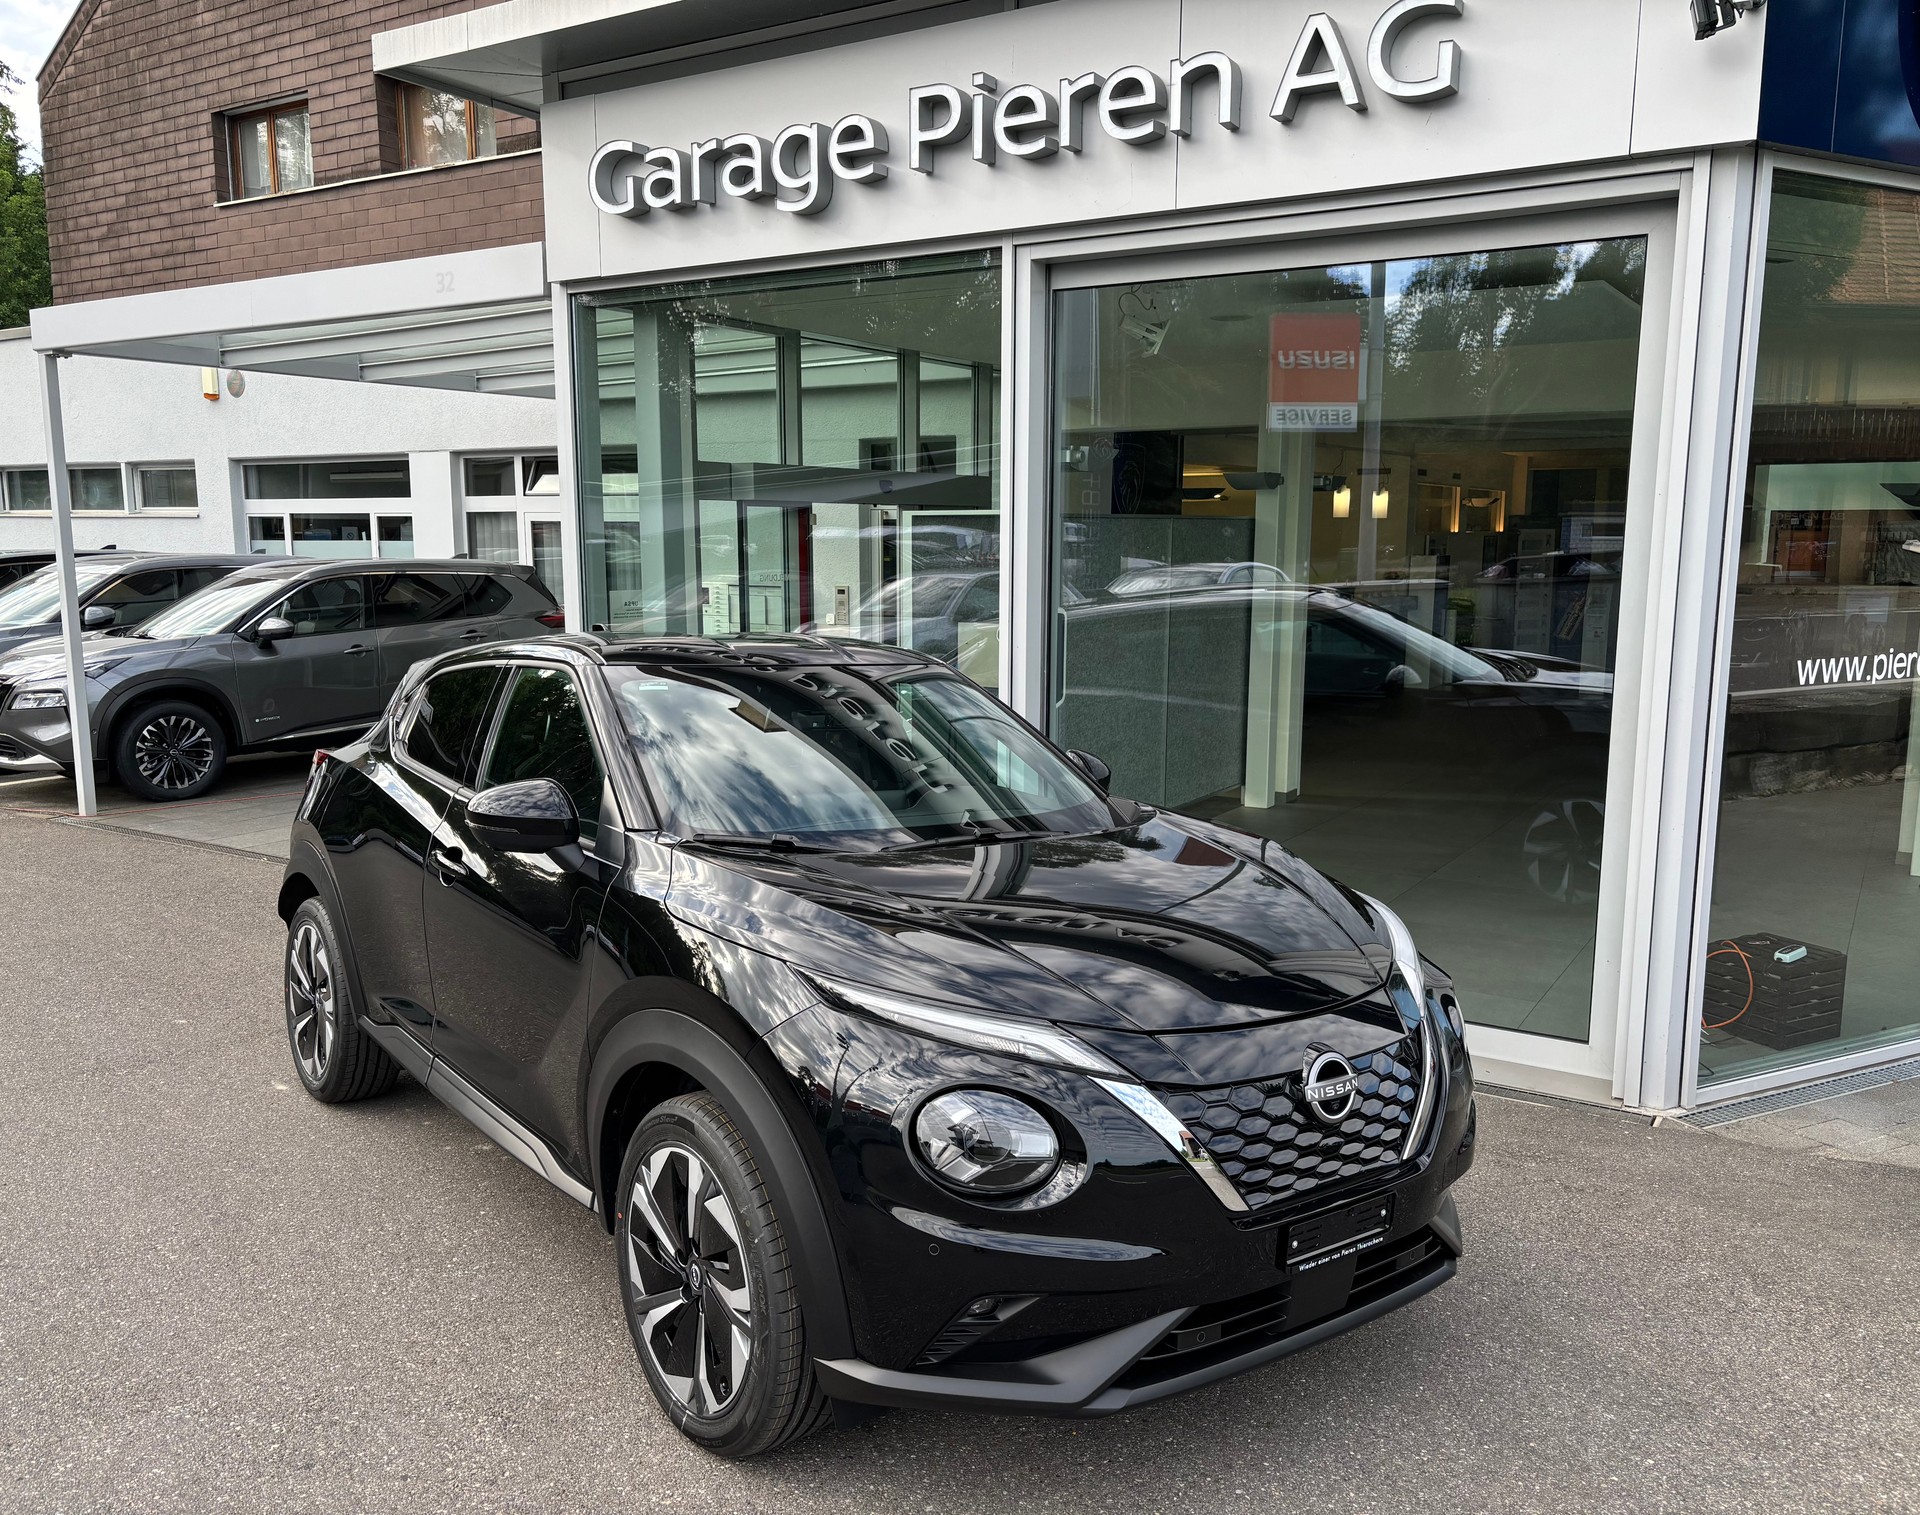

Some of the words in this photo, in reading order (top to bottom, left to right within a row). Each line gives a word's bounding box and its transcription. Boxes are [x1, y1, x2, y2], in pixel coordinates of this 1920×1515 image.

[588, 113, 889, 217] Garage
[909, 50, 1243, 174] Pieren
[1269, 0, 1464, 124] AG
[435, 271, 455, 294] 32
[1797, 648, 1920, 686] www.pier
[1307, 1077, 1358, 1100] NISSAN
[1299, 1260, 1318, 1272] Wieder
[1318, 1256, 1331, 1265] einer
[1332, 1252, 1341, 1260] von
